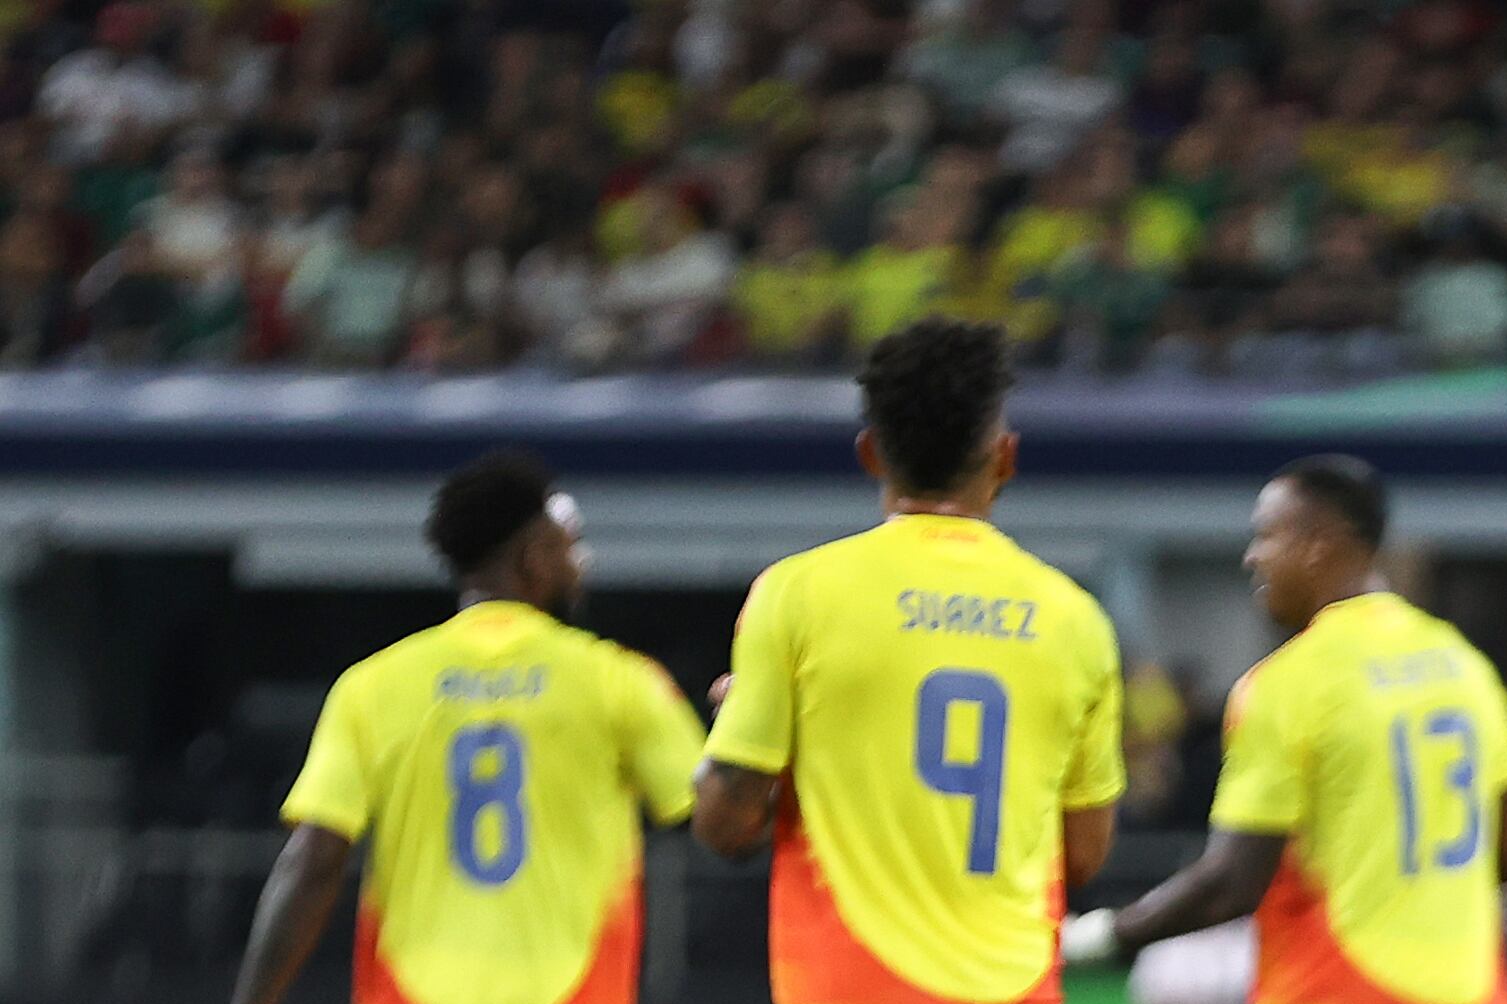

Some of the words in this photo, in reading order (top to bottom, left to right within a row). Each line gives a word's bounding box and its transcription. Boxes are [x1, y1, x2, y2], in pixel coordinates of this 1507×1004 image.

[897, 588, 1040, 641] SUAREZ
[449, 722, 526, 886] 8
[915, 668, 1009, 875] 9
[1390, 707, 1481, 876] 13
